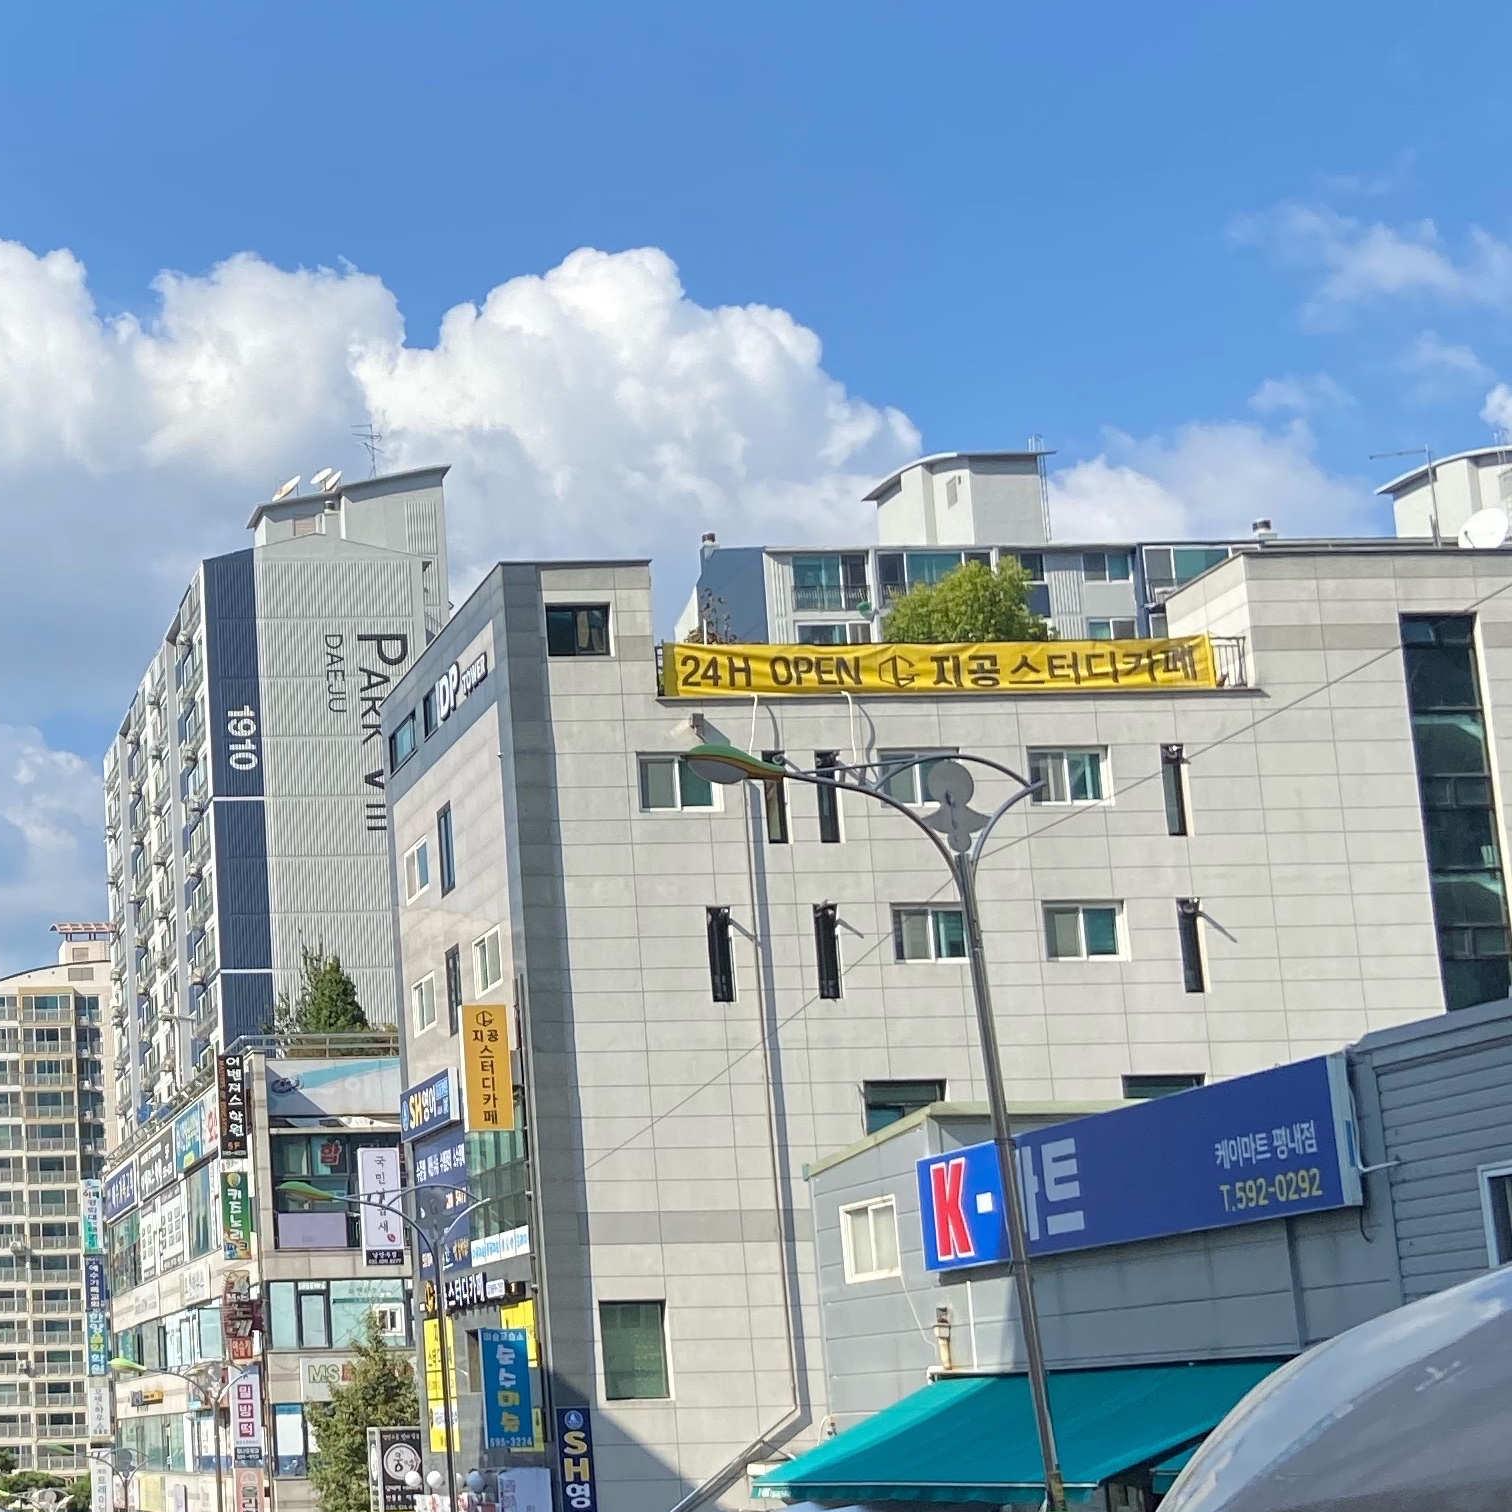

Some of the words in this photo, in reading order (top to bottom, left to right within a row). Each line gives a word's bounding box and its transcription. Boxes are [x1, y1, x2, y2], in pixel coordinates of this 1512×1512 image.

[324, 633, 347, 714] DAEJU
[461, 651, 489, 697] TOWER
[680, 654, 753, 689] 24H
[770, 655, 862, 687] OPEN
[227, 703, 260, 771] 1910
[471, 1028, 499, 1043] 지공
[408, 1084, 437, 1130] SH영어
[478, 1045, 500, 1126] 스터디카페
[1213, 1133, 1272, 1170] 케이마트
[1272, 1119, 1319, 1161] 평내점
[1219, 1168, 1324, 1213] T.592-0292
